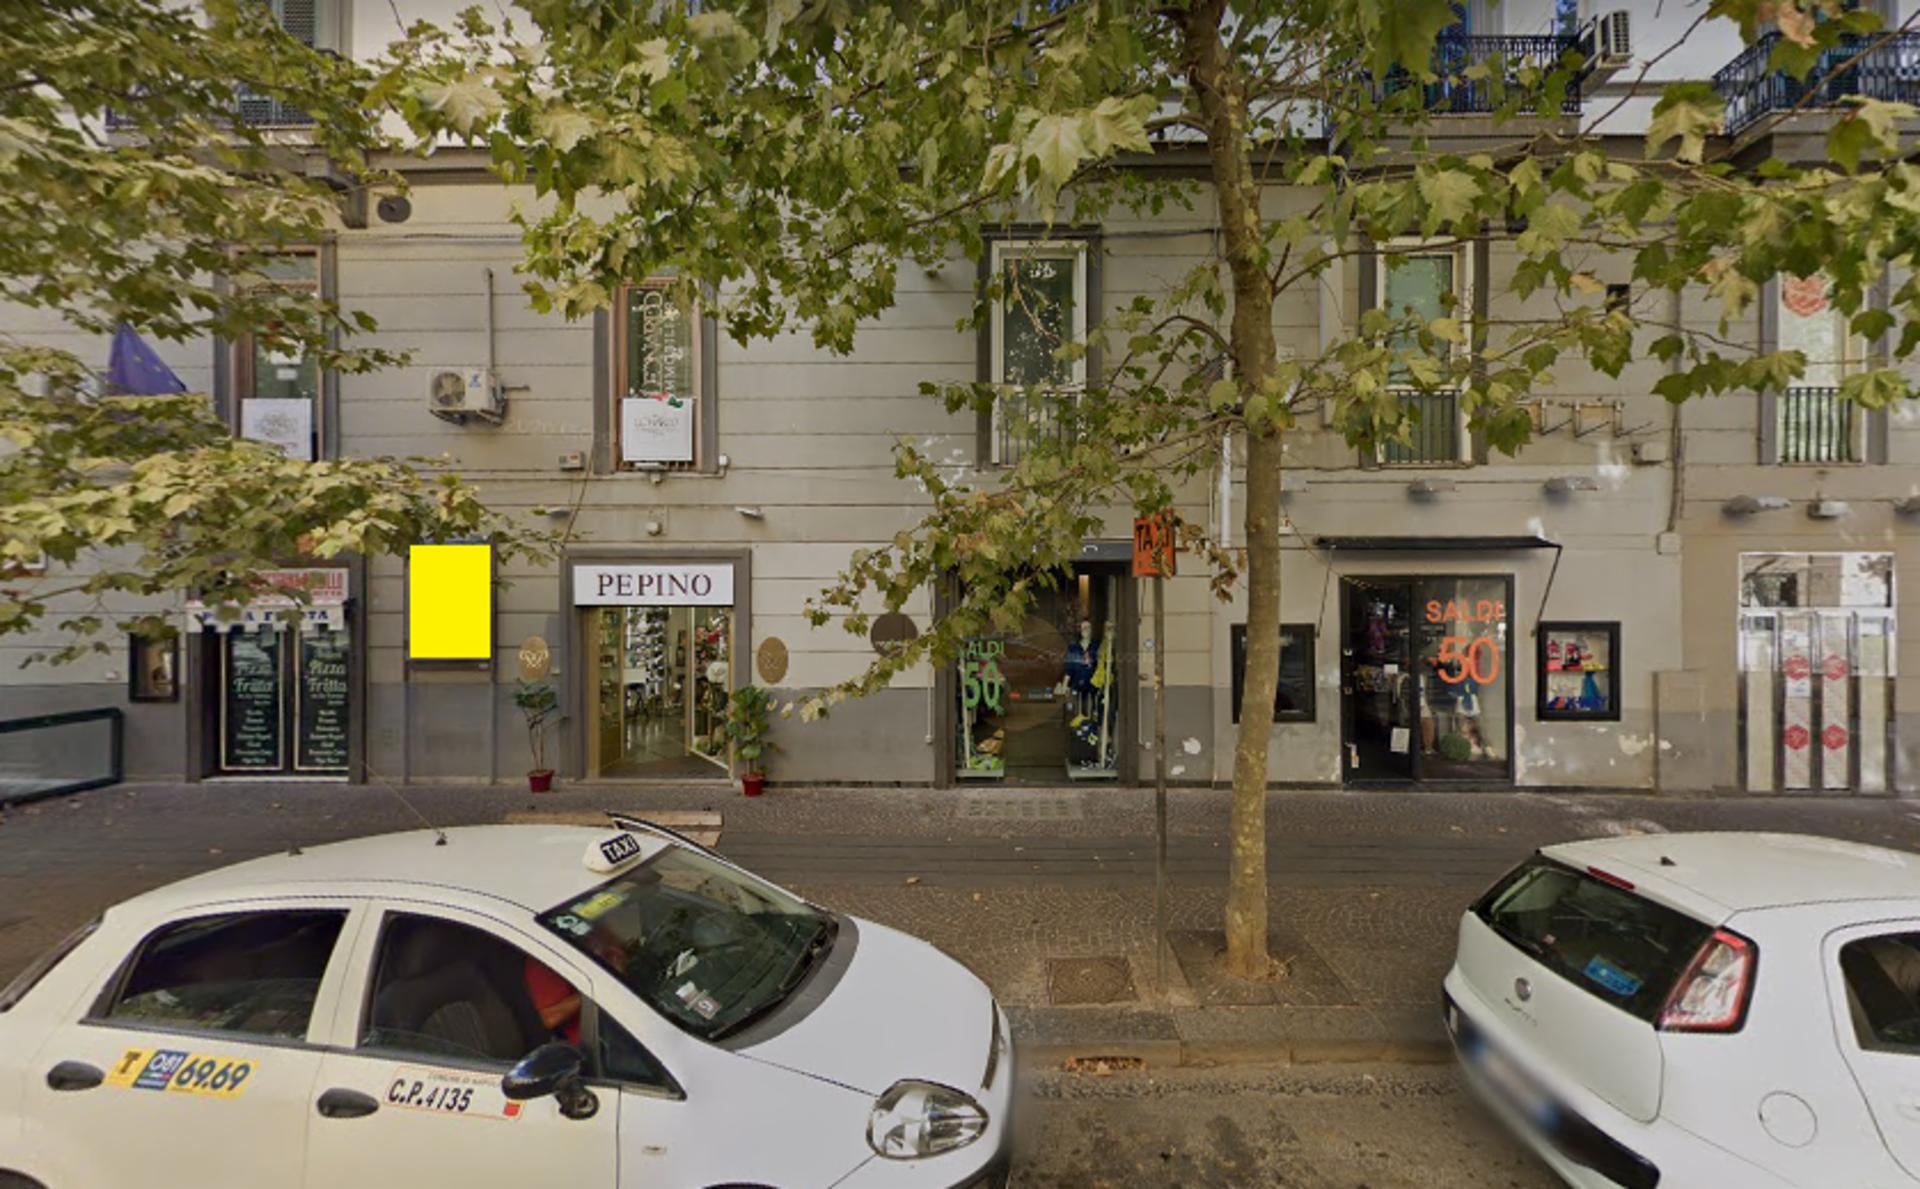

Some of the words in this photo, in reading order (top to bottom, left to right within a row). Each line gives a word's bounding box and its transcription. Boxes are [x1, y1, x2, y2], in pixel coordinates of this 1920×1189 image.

[597, 573, 712, 597] PEPINO
[602, 836, 638, 861] TAXI
[120, 1052, 141, 1074] T
[176, 1059, 250, 1091] 69.69
[389, 1078, 474, 1111] C.P.4135
